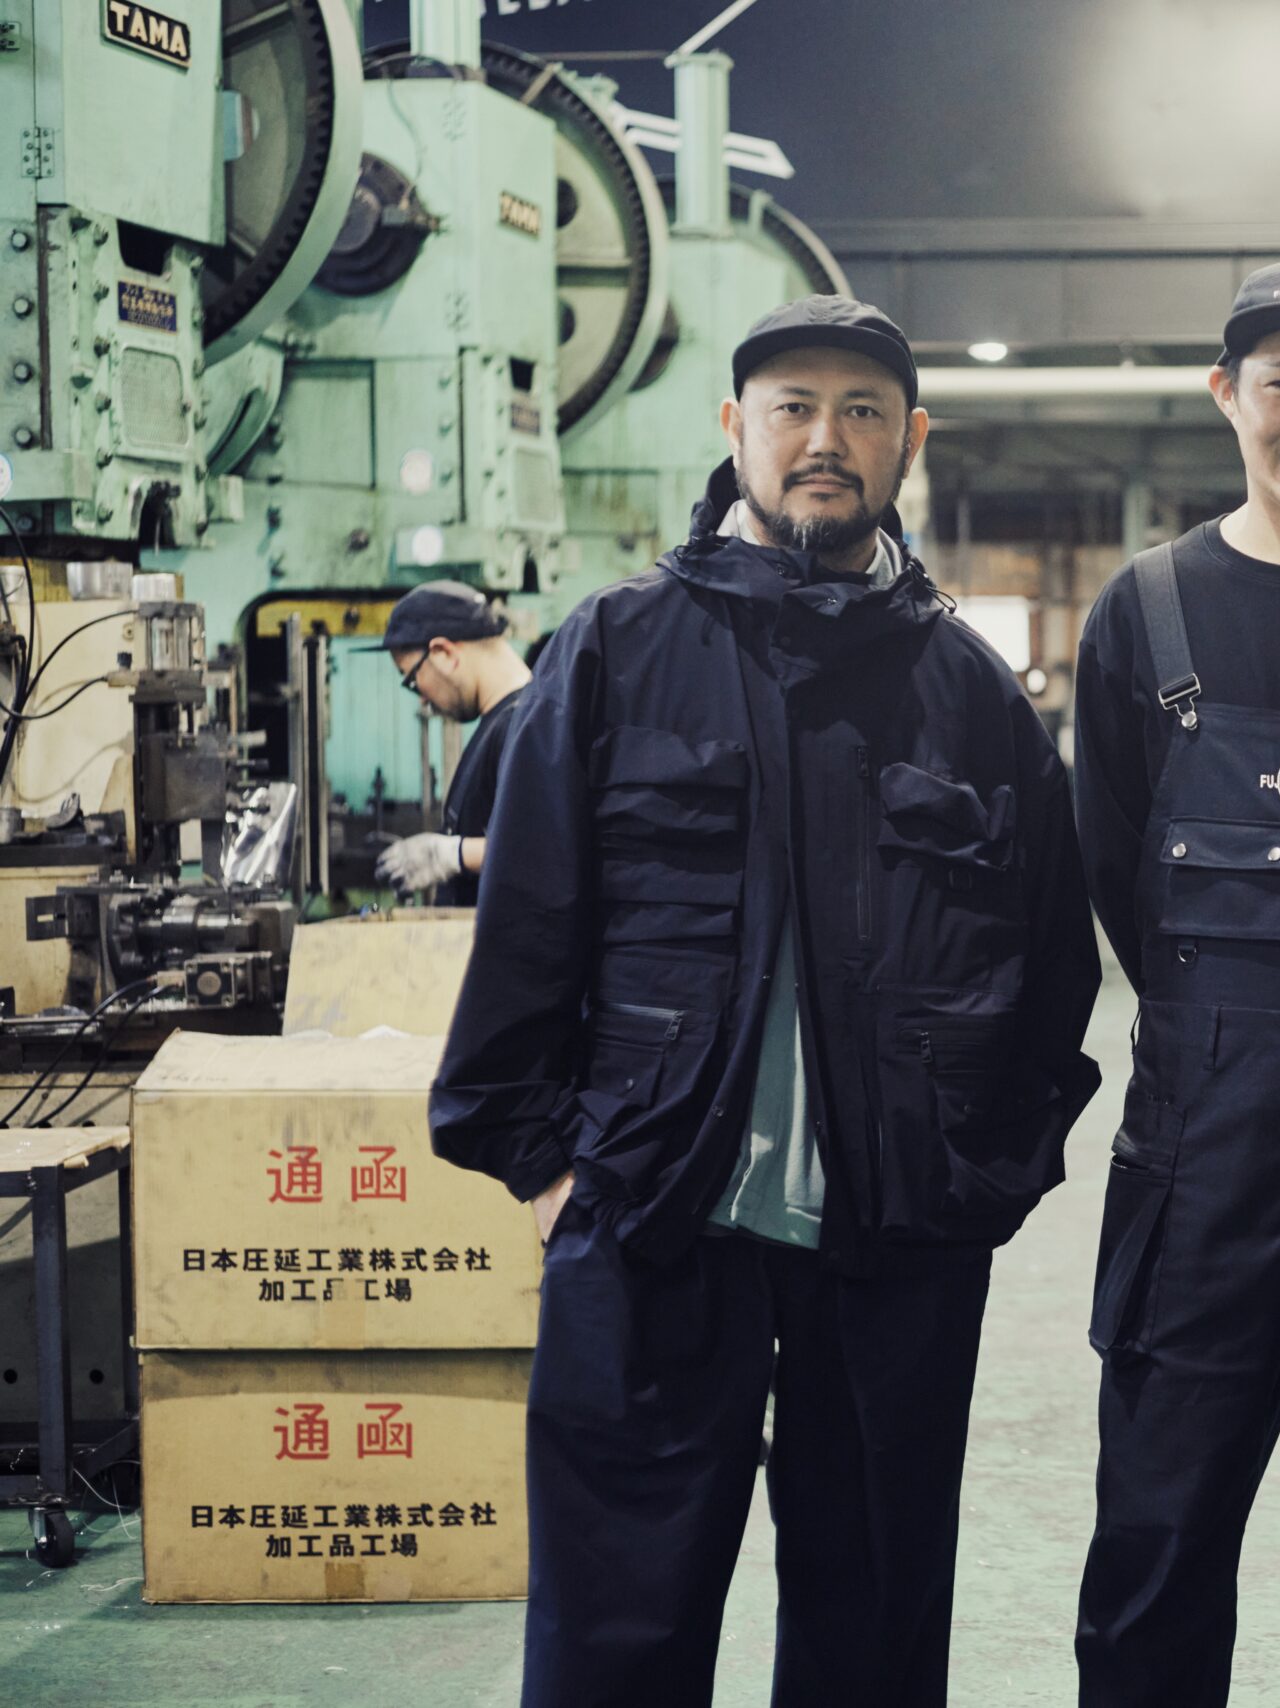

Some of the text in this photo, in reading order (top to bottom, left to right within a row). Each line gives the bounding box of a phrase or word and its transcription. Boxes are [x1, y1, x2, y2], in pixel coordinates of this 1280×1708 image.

[110, 0, 188, 57] TAMA
[182, 1247, 493, 1273] 日本圧延工業株式会社
[190, 1502, 498, 1529] 日本圧延工業株式会社
[265, 1533, 419, 1558] 加工品工場
